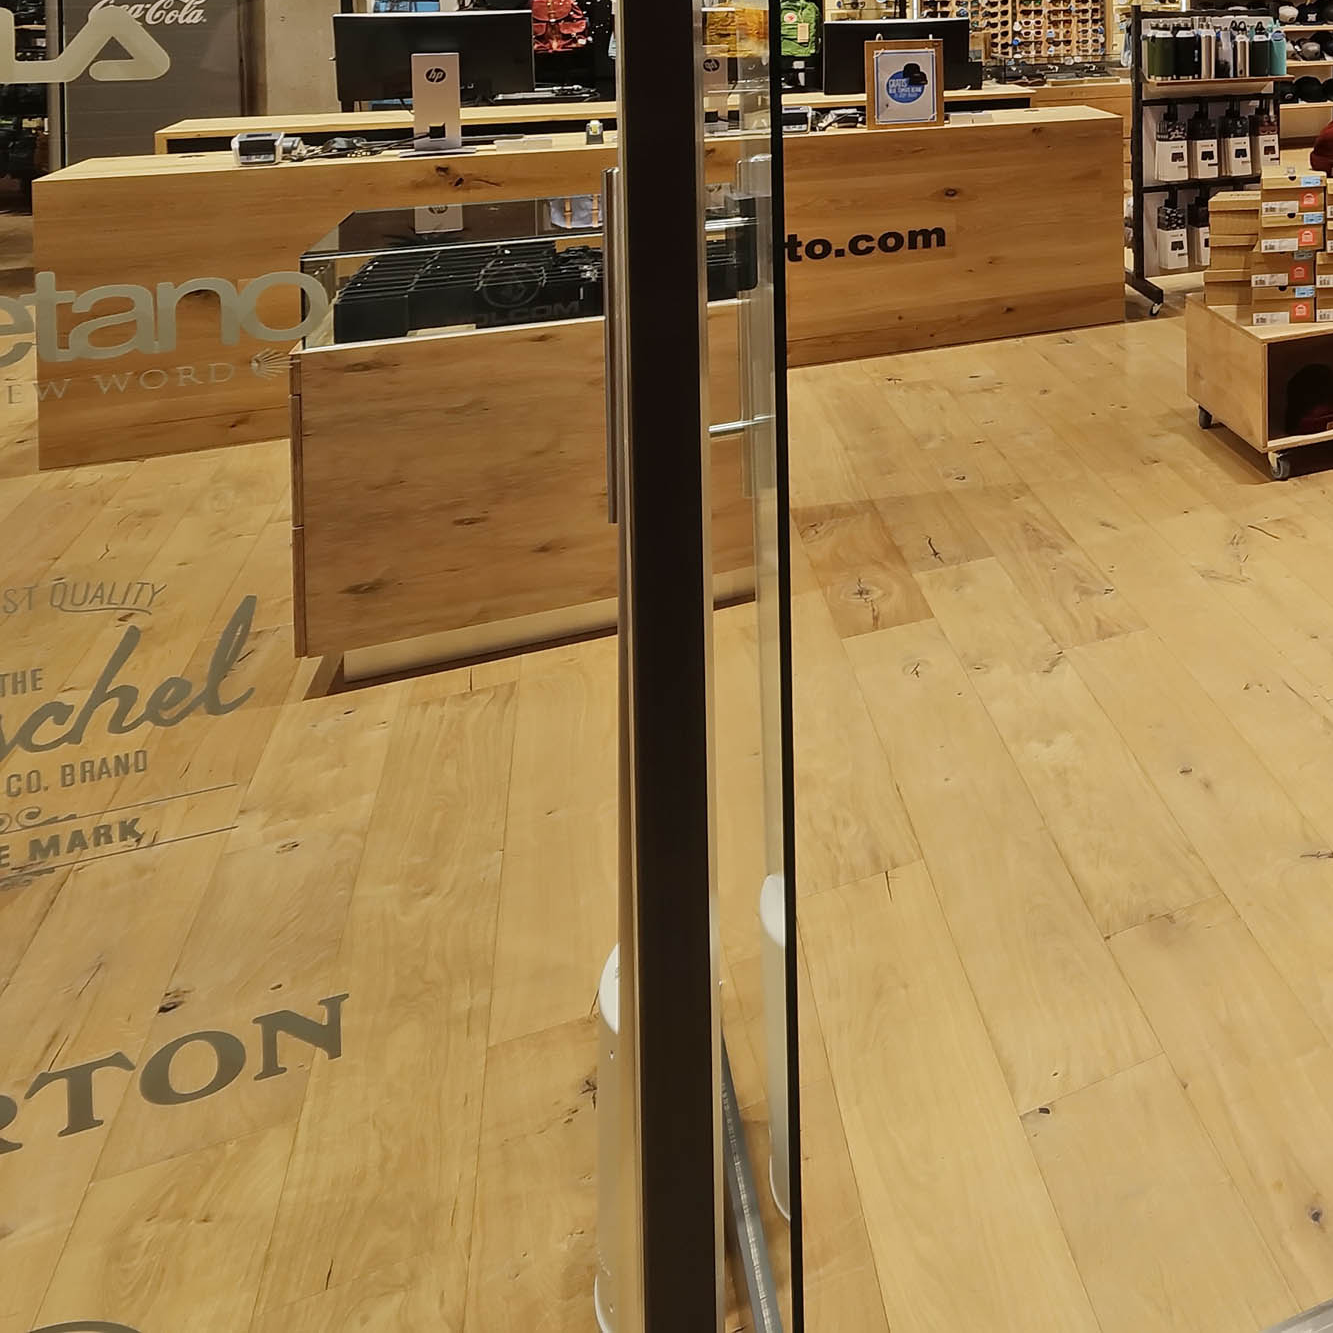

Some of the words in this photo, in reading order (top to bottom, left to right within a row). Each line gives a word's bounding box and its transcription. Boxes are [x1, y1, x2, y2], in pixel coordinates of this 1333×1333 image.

[425, 67, 447, 83] hp
[95, 362, 239, 395] WORD
[50, 580, 168, 616] QUALITY
[6, 769, 49, 798] CO.
[61, 749, 147, 788] BRAND
[28, 817, 146, 862] MARK
[0, 993, 351, 1155] TON
